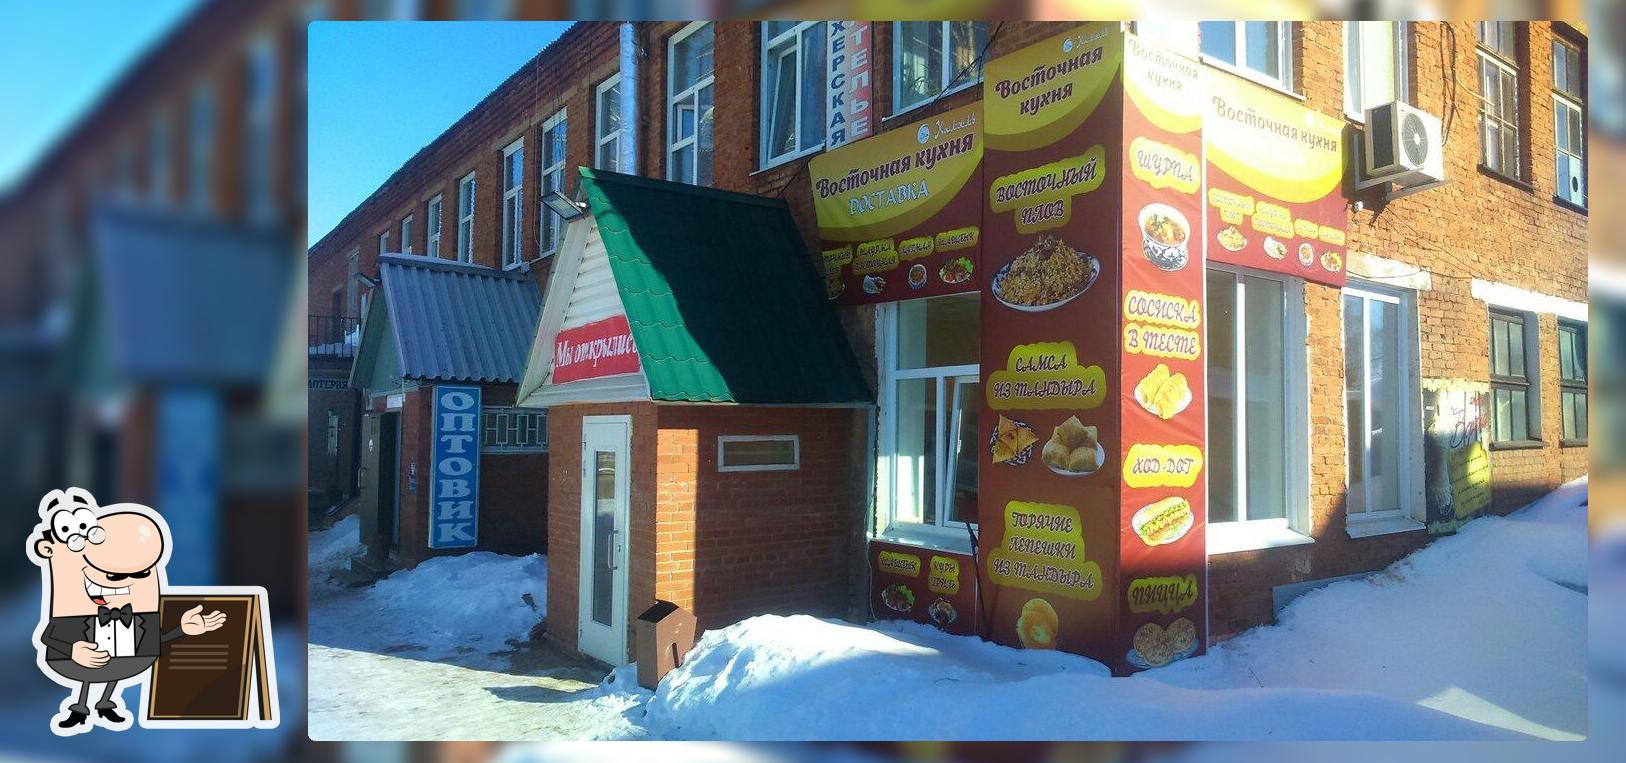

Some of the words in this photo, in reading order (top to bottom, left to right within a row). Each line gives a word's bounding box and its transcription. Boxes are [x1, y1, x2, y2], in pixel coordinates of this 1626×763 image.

[995, 47, 1103, 99] Восточная
[1128, 39, 1198, 79] Восточная
[1020, 82, 1073, 117] кухня
[1212, 95, 1299, 140] Восточная
[1301, 129, 1338, 153] кухня
[815, 155, 911, 199] Восточная
[914, 133, 974, 171] кухня
[996, 158, 1097, 203] ВОСТОЧНЫЙ
[1137, 150, 1194, 182] ШУРПА
[1021, 200, 1065, 225] ПЛОВ
[1128, 296, 1196, 323] СОСИСКА
[556, 340, 573, 368] Мы
[1128, 328, 1139, 348] В
[1143, 331, 1197, 355] ТЕСТЕ
[1015, 354, 1068, 372] САМСА
[994, 382, 1011, 398] ИЗ
[1015, 379, 1097, 397] ТАНДЫРА
[438, 391, 475, 542] ОПТОВИК
[1012, 512, 1074, 533] ГОРЯЧИЕ
[1008, 536, 1077, 560] ЛЕПЕШКИ
[993, 558, 1011, 576] ИЗ
[1014, 560, 1094, 589] ТАНДЫРА
[1132, 580, 1194, 607] ПИЦЦА
